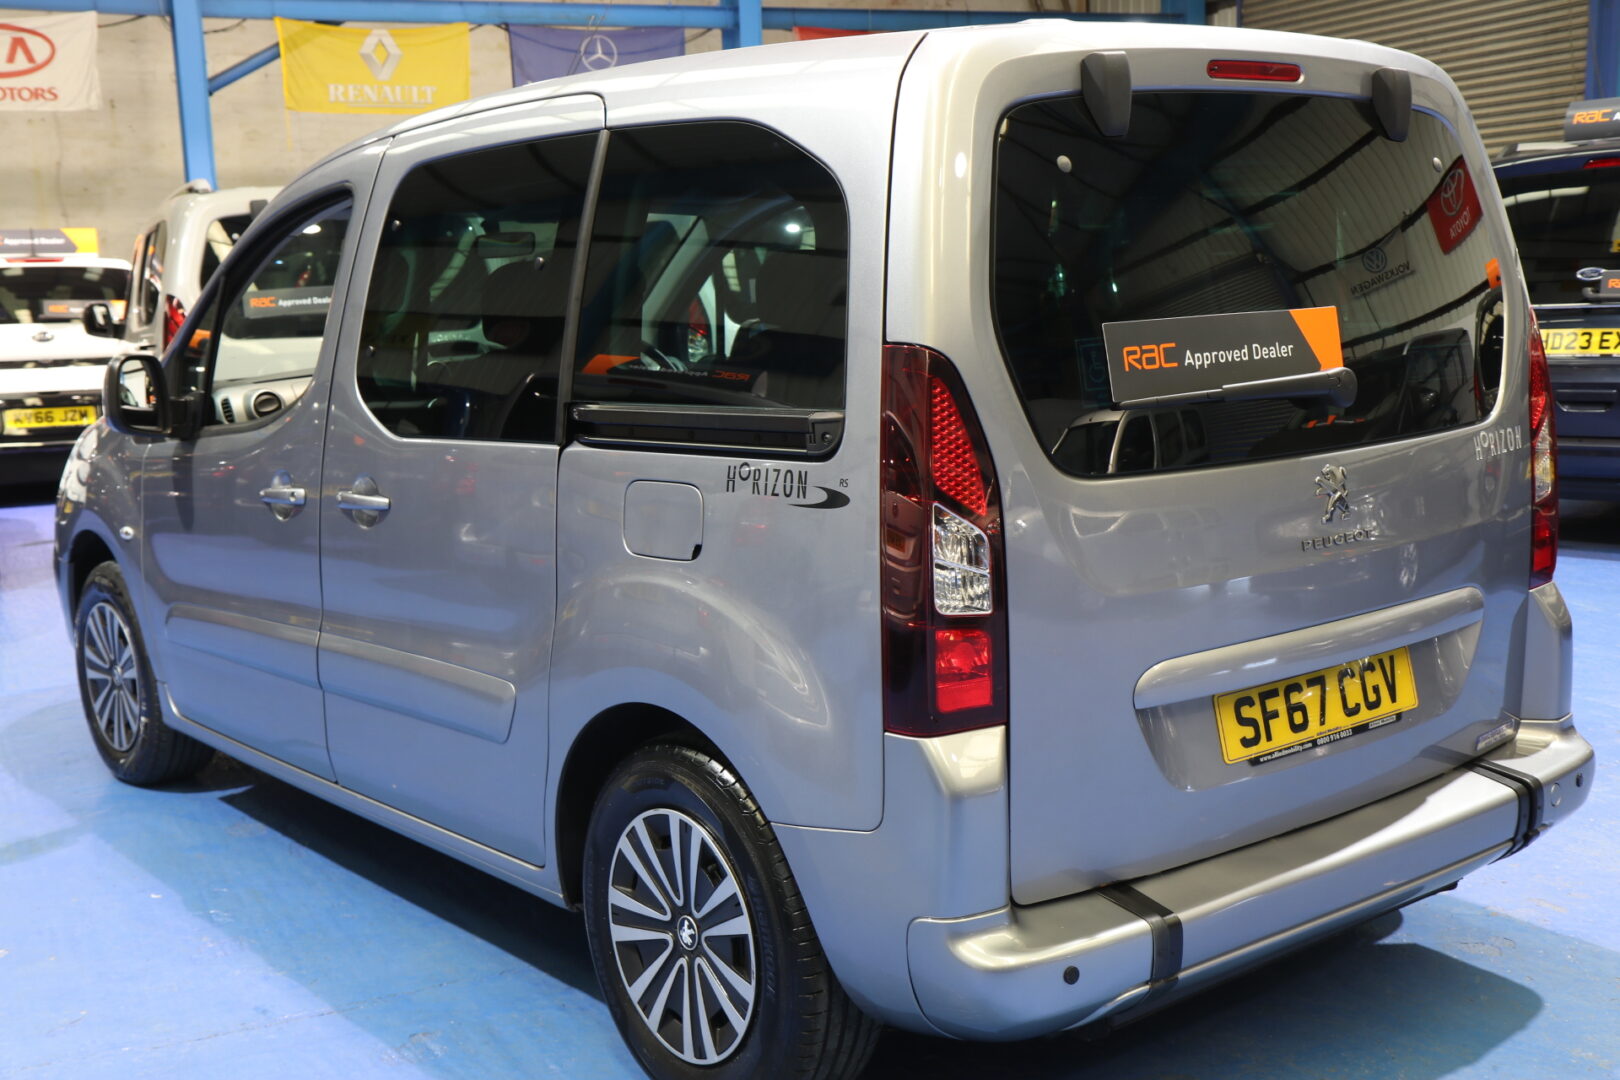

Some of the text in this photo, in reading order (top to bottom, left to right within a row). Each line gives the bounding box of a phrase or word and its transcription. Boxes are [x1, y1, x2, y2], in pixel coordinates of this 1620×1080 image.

[327, 83, 438, 104] RENAULT
[1184, 345, 1249, 370] Approved
[1252, 341, 1294, 361] Dealer
[1473, 425, 1523, 460] HORIZON
[726, 462, 849, 499] HORIZON RS
[1301, 529, 1373, 552] PEUGEOT
[1233, 654, 1398, 749] SF67 CGV
